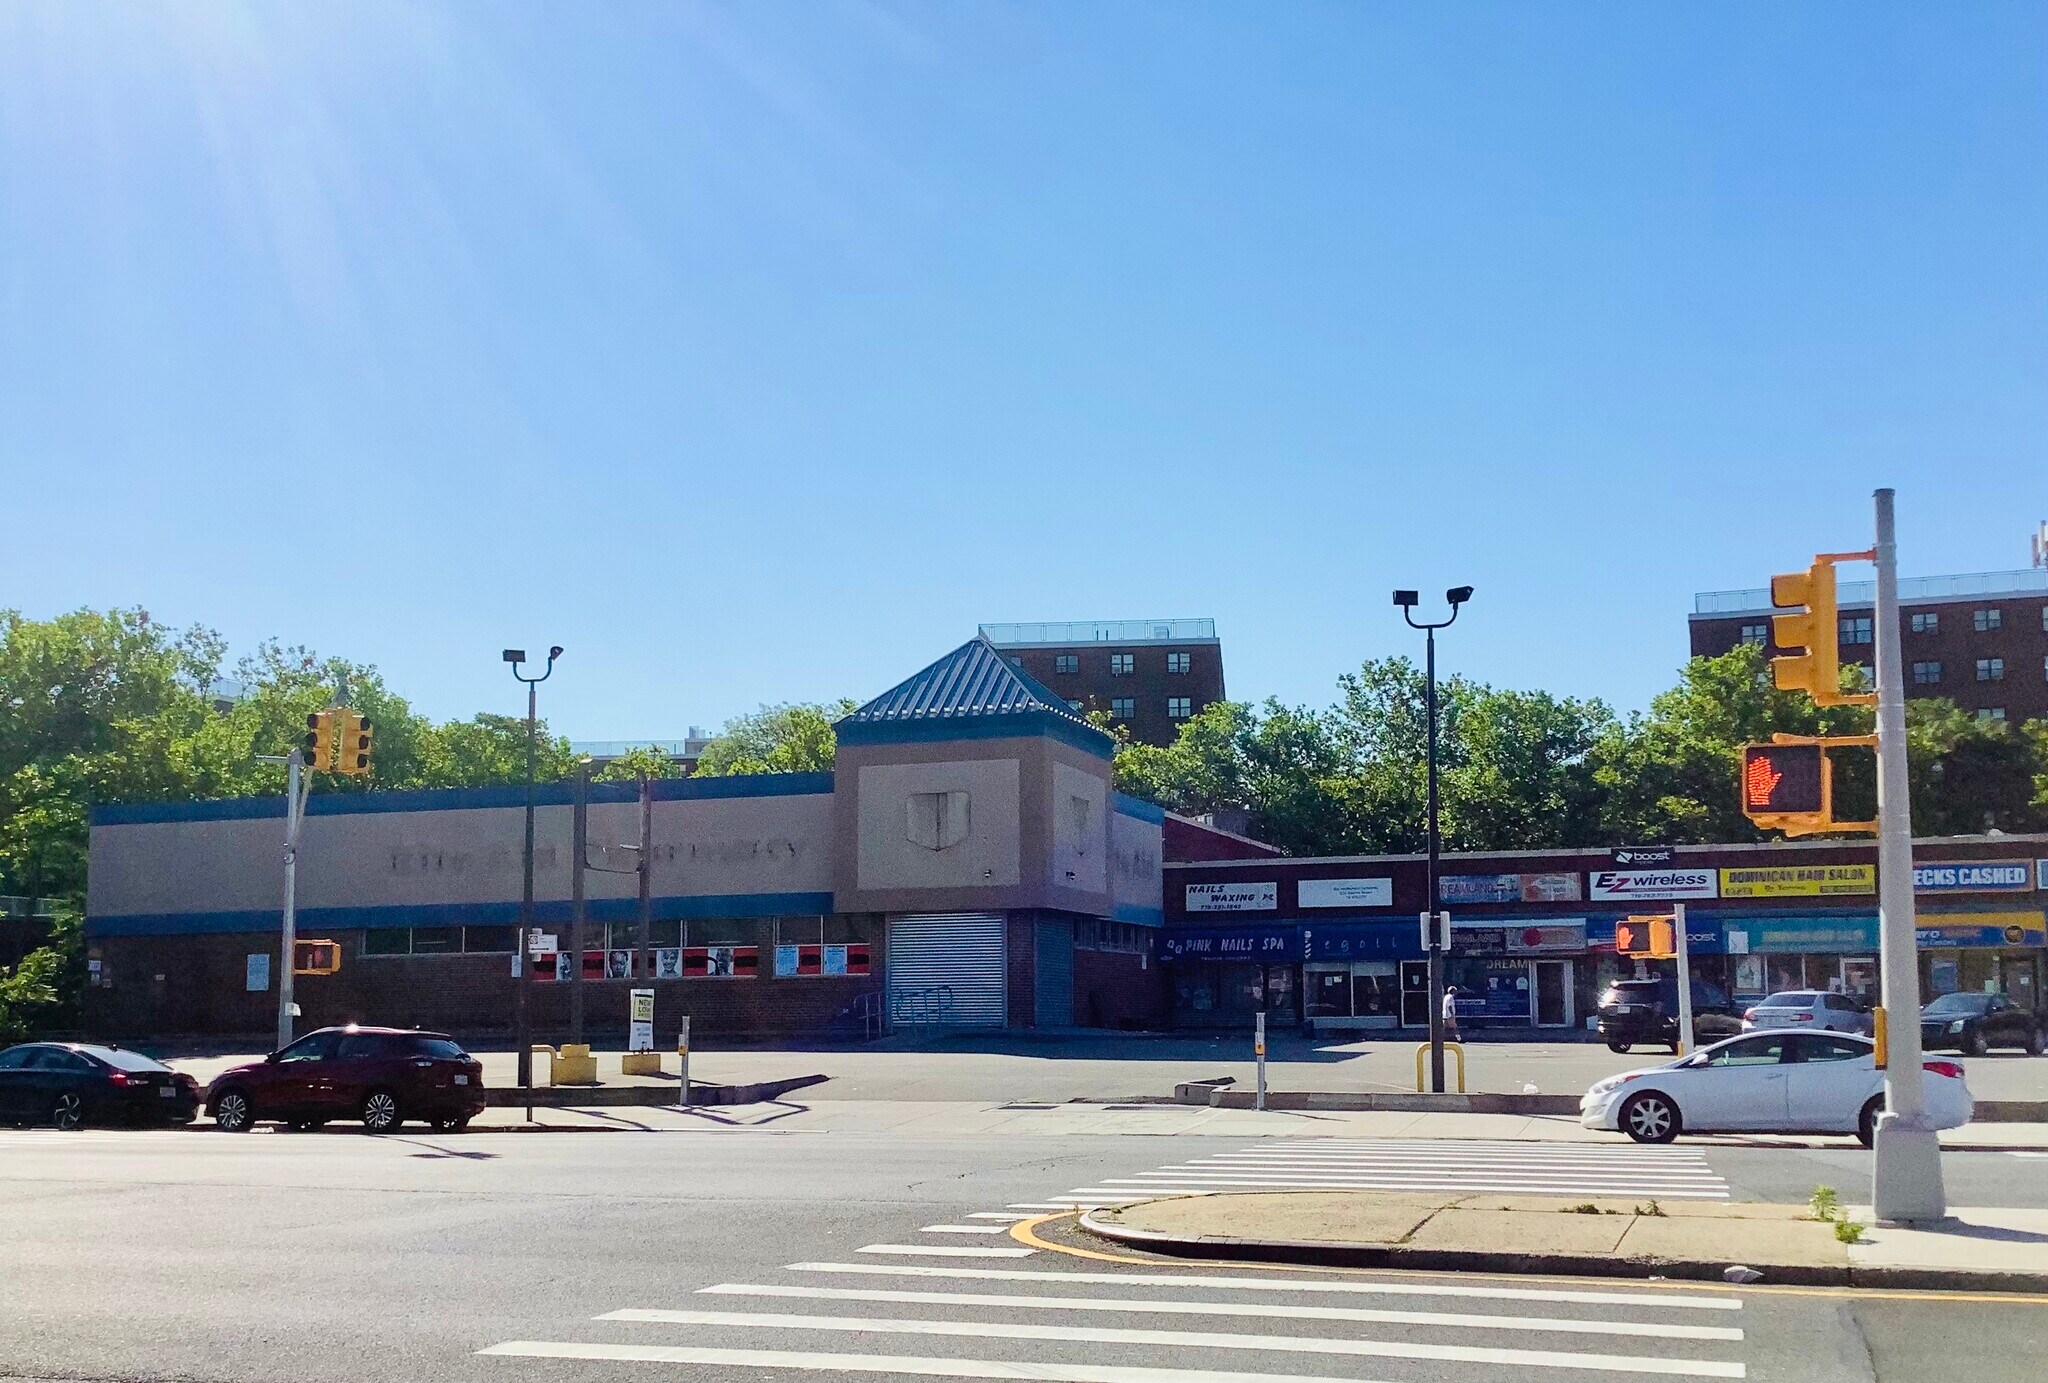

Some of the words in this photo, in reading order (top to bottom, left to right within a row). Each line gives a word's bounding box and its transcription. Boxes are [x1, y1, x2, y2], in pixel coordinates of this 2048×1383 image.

[1634, 851, 1671, 861] boost
[1633, 873, 1707, 886] wireless
[1828, 867, 1866, 880] SALON
[1958, 867, 2028, 885] CASHED
[1188, 885, 1225, 894] NAILS
[1210, 893, 1255, 902] WAXING
[1185, 939, 1213, 952] PINK
[1221, 938, 1254, 952] NAILS
[1262, 937, 1285, 951] SPA
